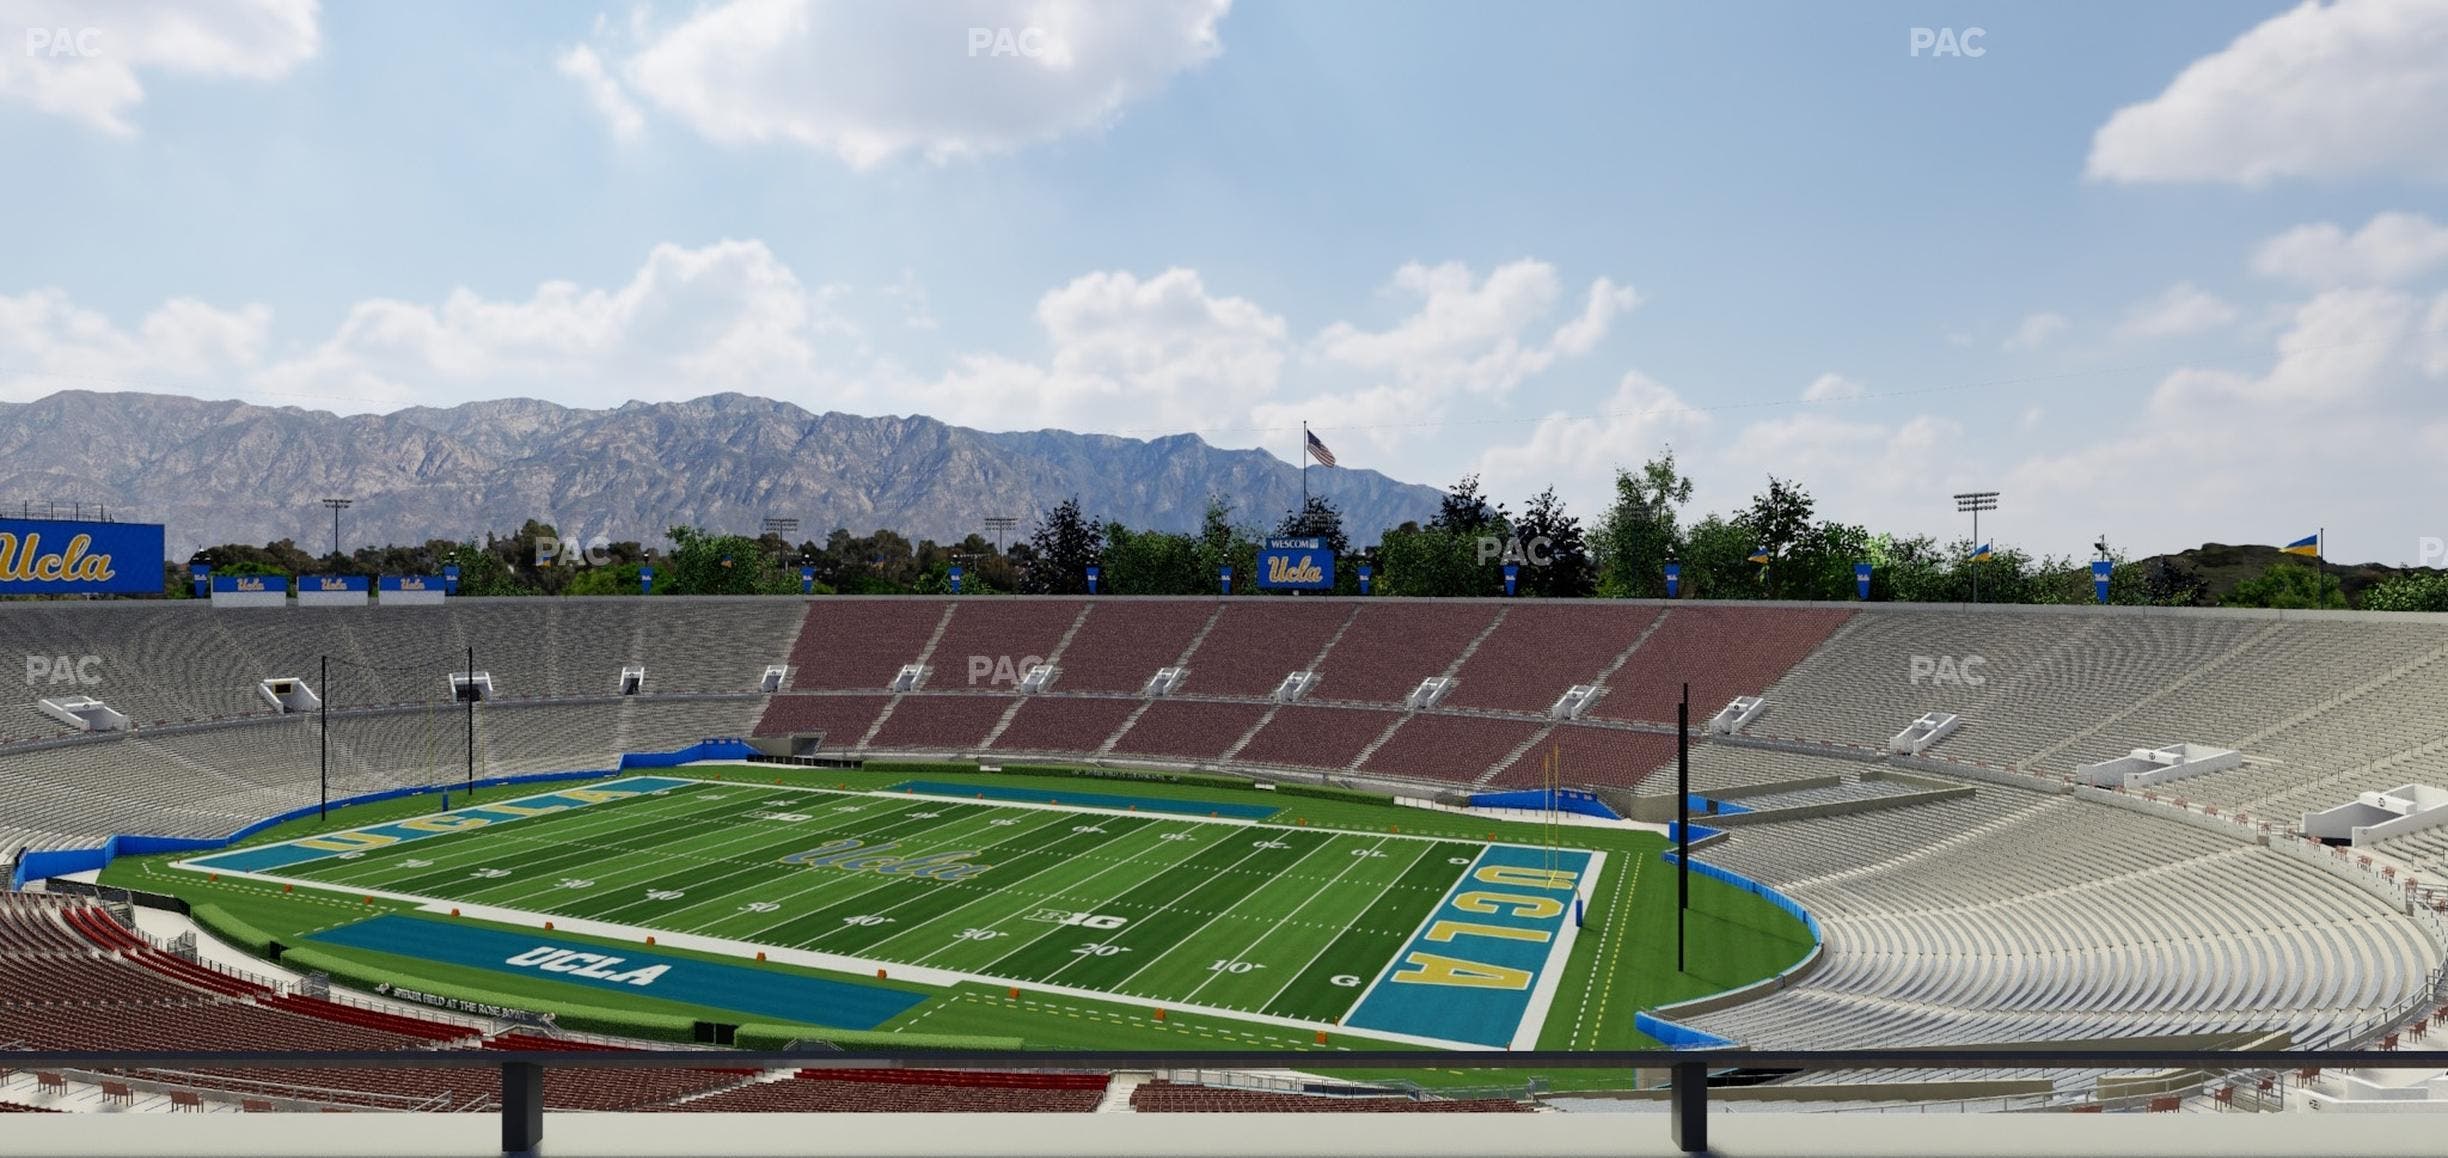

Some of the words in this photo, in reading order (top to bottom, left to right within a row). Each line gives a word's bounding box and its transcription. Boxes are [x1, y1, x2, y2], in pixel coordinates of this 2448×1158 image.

[1271, 540, 1309, 549] WESCOM
[1268, 555, 1323, 583] Ucla
[779, 839, 992, 880] Ucla
[952, 928, 997, 941] 30
[1070, 943, 1120, 957] 20
[505, 946, 672, 986] UCLA
[1206, 960, 1253, 974] 10
[1330, 975, 1361, 987] G
[423, 993, 445, 1006] FIELD
[446, 998, 458, 1008] AT
[459, 1001, 477, 1013] THE
[478, 1003, 501, 1016] ROSE
